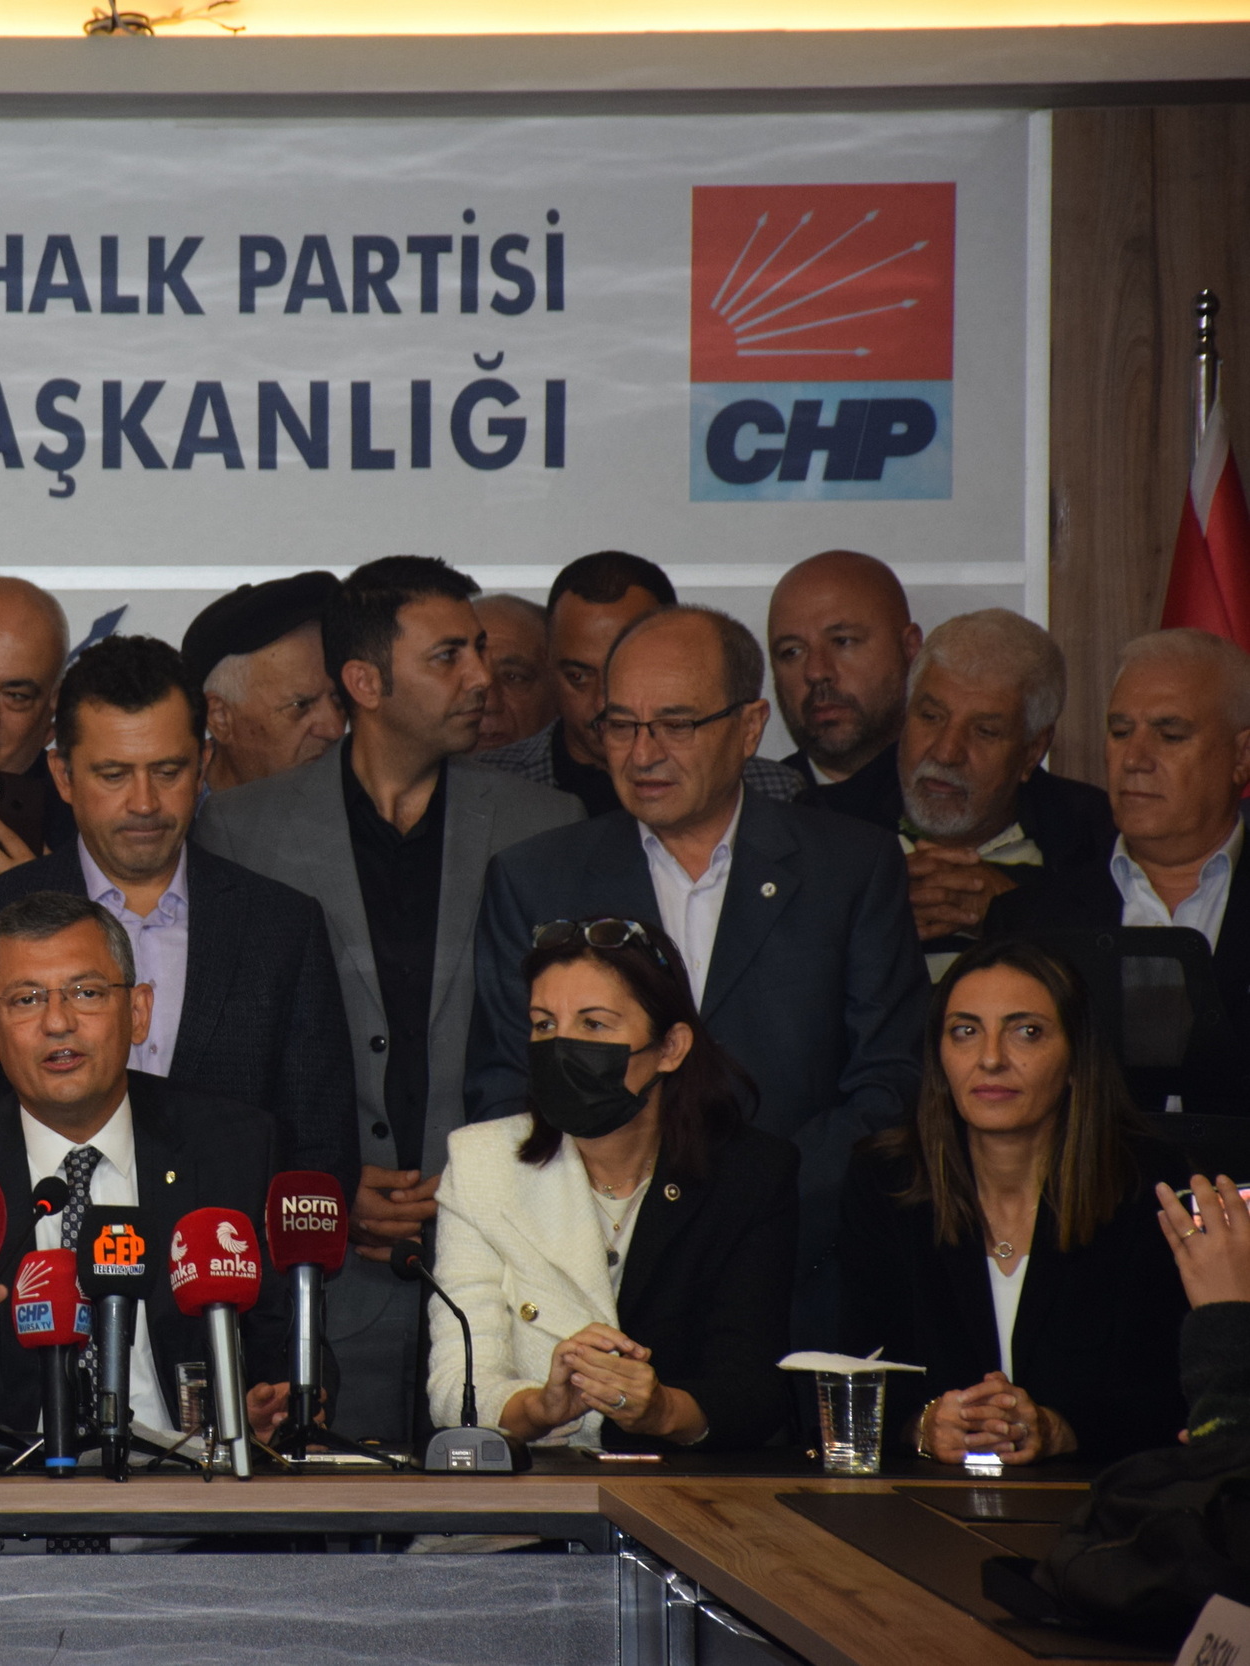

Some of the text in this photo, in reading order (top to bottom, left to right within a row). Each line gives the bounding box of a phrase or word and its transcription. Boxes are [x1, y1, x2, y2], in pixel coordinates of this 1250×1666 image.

[238, 208, 566, 316] PARTİSİ
[706, 397, 938, 485] CHP
[282, 1196, 338, 1216] Norm
[282, 1214, 338, 1232] Haber
[93, 1236, 146, 1266] CEP
[210, 1254, 257, 1274] anka
[17, 1304, 49, 1323] CHP
[41, 1321, 51, 1330] TV
